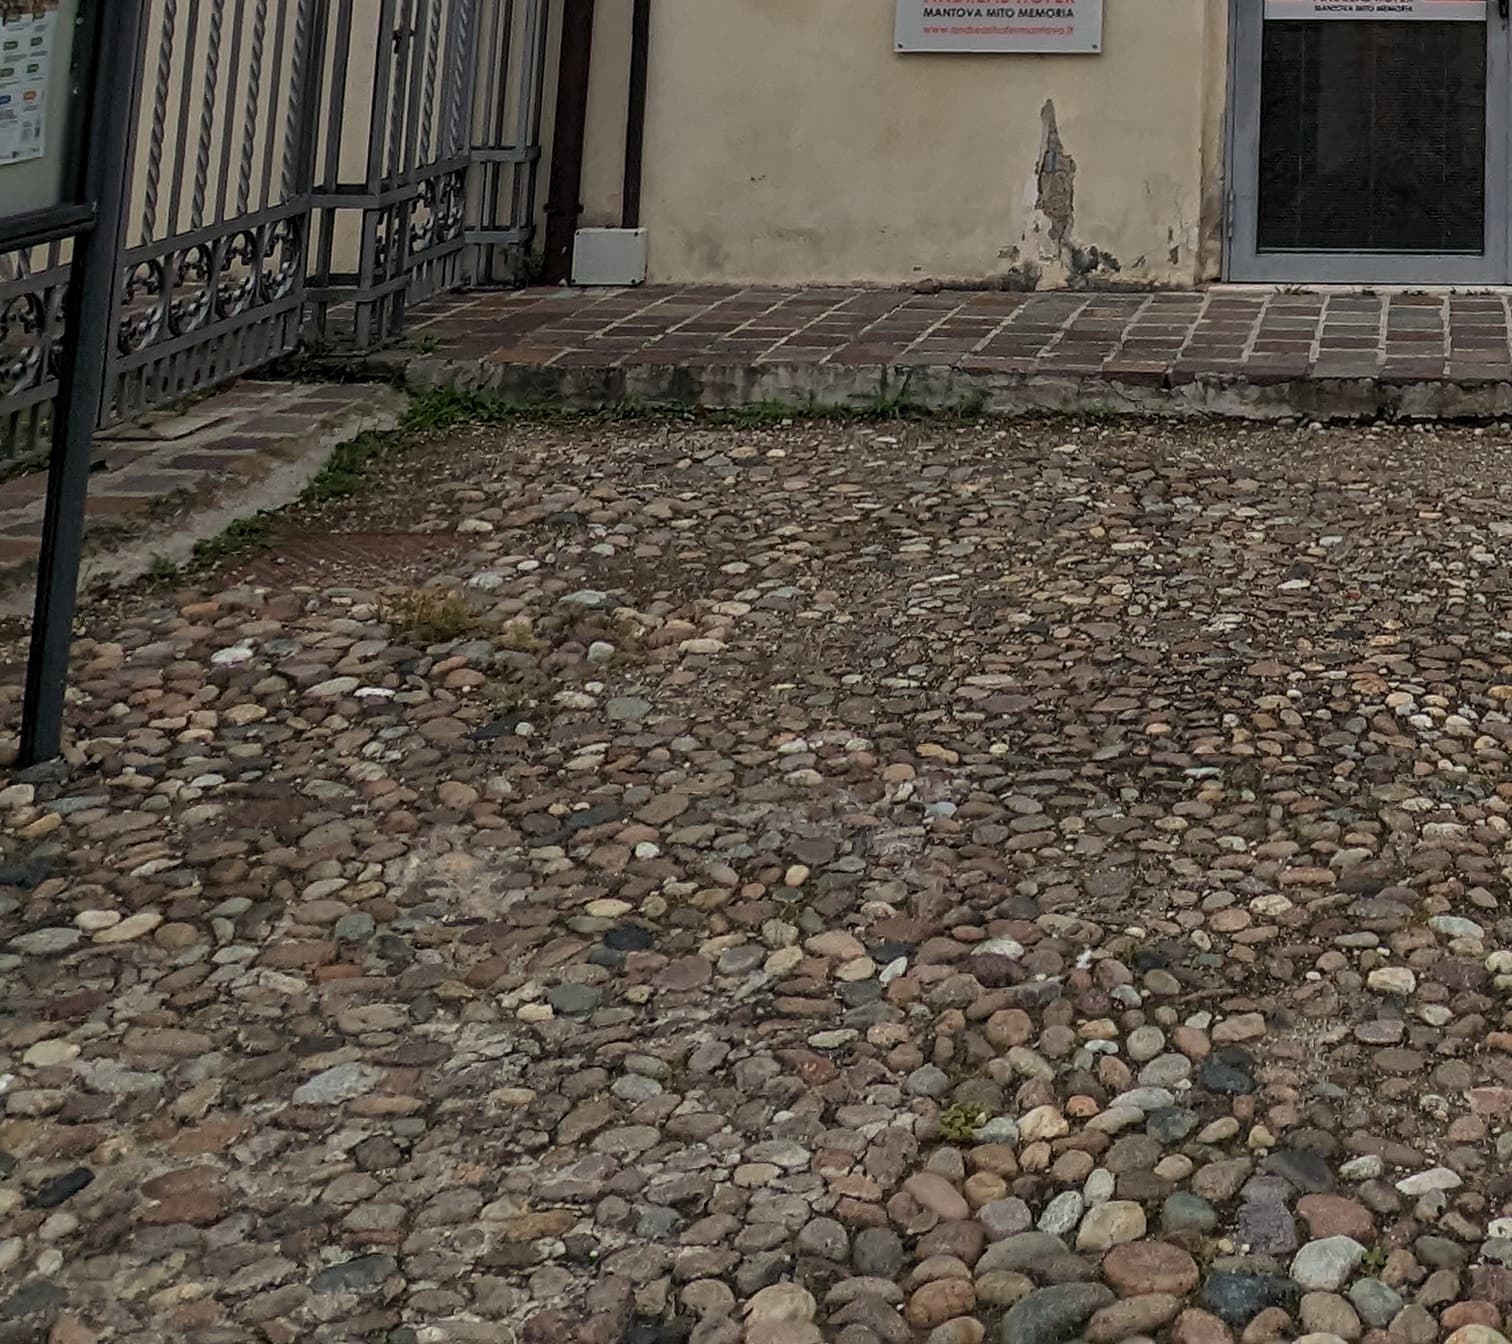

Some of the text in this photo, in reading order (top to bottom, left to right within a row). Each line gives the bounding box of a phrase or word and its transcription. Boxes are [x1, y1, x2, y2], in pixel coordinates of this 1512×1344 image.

[923, 8, 1075, 18] MANTOVA MITO MEMORIA
